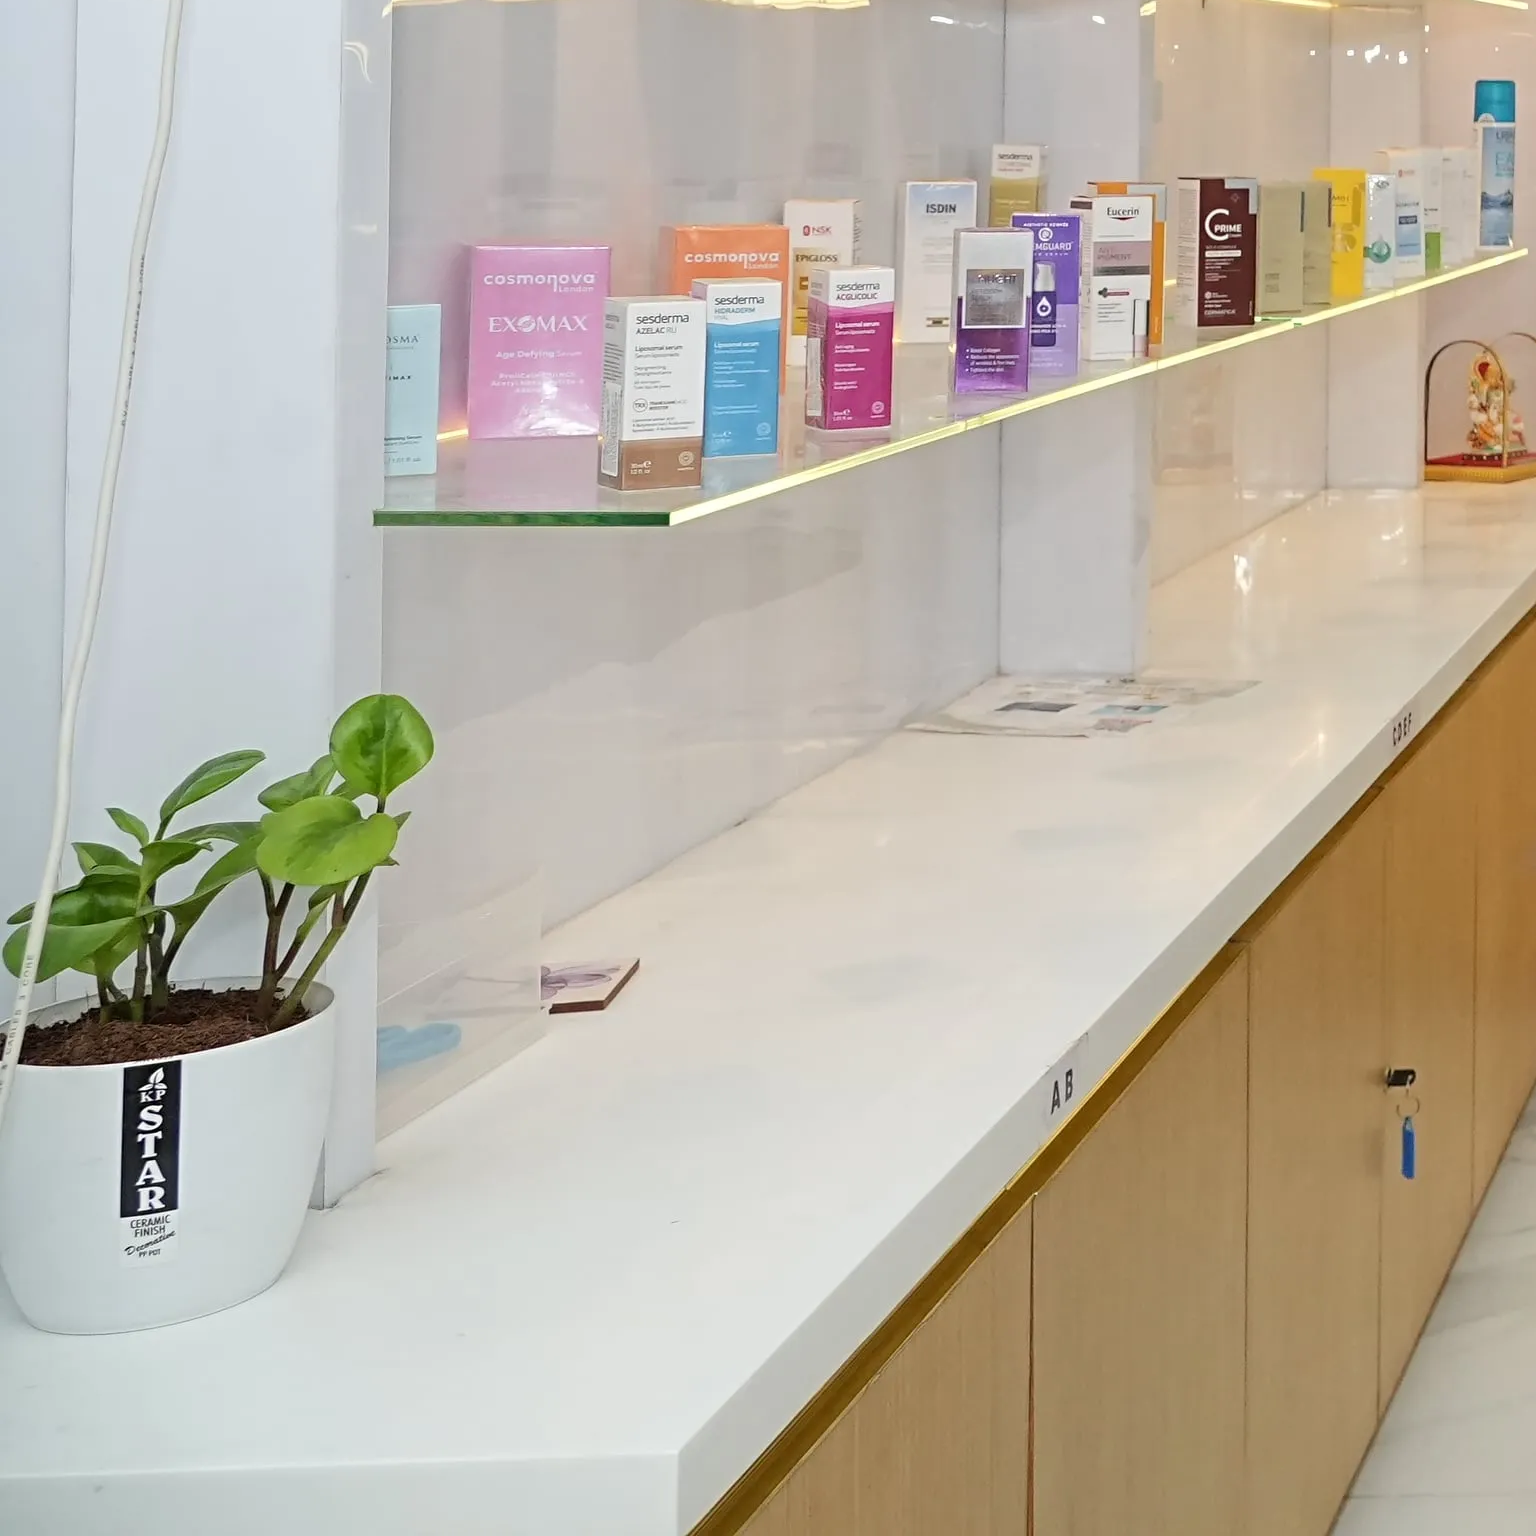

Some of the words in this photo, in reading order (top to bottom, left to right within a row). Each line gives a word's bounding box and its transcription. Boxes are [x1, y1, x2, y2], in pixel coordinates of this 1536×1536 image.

[926, 204, 956, 213] ISDIN
[1107, 207, 1139, 215] Eucerin
[1215, 224, 1241, 232] PRIME
[685, 251, 779, 268] cosmonova
[795, 254, 838, 262] EPIGLOSS
[484, 273, 595, 292] cosmonova
[836, 283, 880, 292] sesderma
[715, 296, 764, 305] sesderma
[489, 315, 588, 332] EXOMAX
[636, 314, 689, 324] sesderma
[496, 351, 515, 359] Age
[517, 350, 555, 359] Defying
[141, 1089, 165, 1103] KP
[135, 1104, 165, 1212] STAR
[131, 1215, 171, 1229] CERAMIC
[135, 1225, 165, 1238] FINISH
[125, 1231, 176, 1257] Decorative
